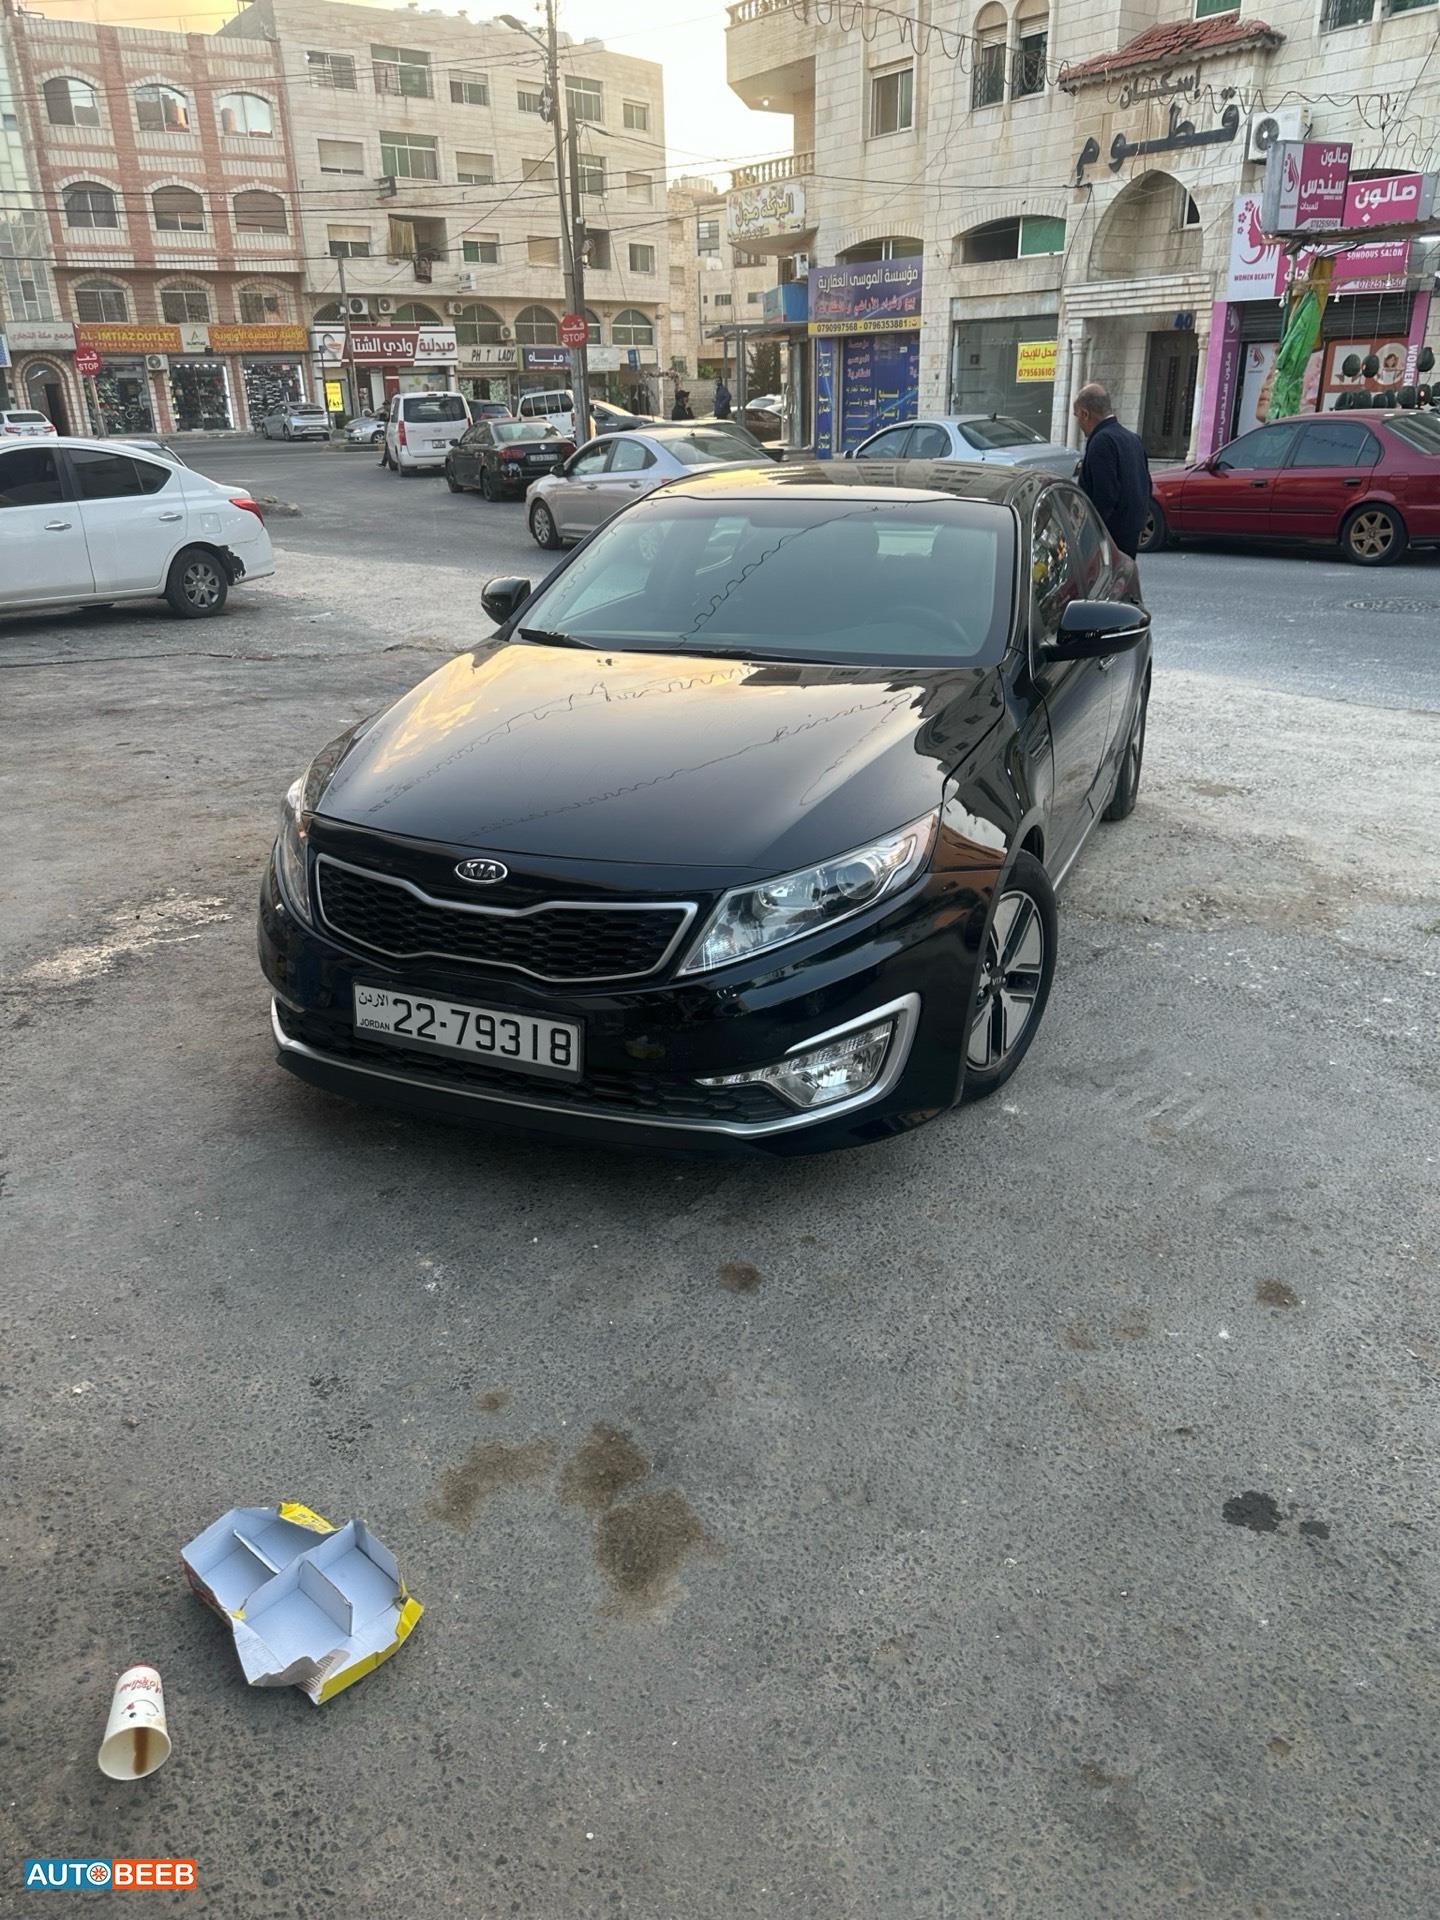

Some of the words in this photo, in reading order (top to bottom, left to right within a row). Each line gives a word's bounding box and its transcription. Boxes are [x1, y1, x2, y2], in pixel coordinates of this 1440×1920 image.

[1076, 86, 1239, 185] قطوم
[1321, 147, 1349, 167] صالون
[1301, 173, 1345, 198] سندس
[1354, 180, 1417, 209] صالون
[1380, 248, 1403, 257] SALON
[818, 272, 848, 293] العقارية
[849, 268, 883, 290] الموسى
[884, 264, 918, 286] مؤسسة
[562, 319, 585, 331] قف
[137, 332, 175, 341] OUTLET
[562, 333, 586, 343] STOP
[383, 340, 414, 357] وادي
[420, 338, 456, 356] صيدلية
[76, 351, 98, 361] قف
[78, 363, 99, 371] STOP
[1403, 344, 1419, 386] WOMEN
[463, 862, 496, 879] KIA
[358, 991, 389, 1008] الاردن
[359, 1018, 390, 1031] JORDAN
[392, 998, 571, 1066] 22-79318
